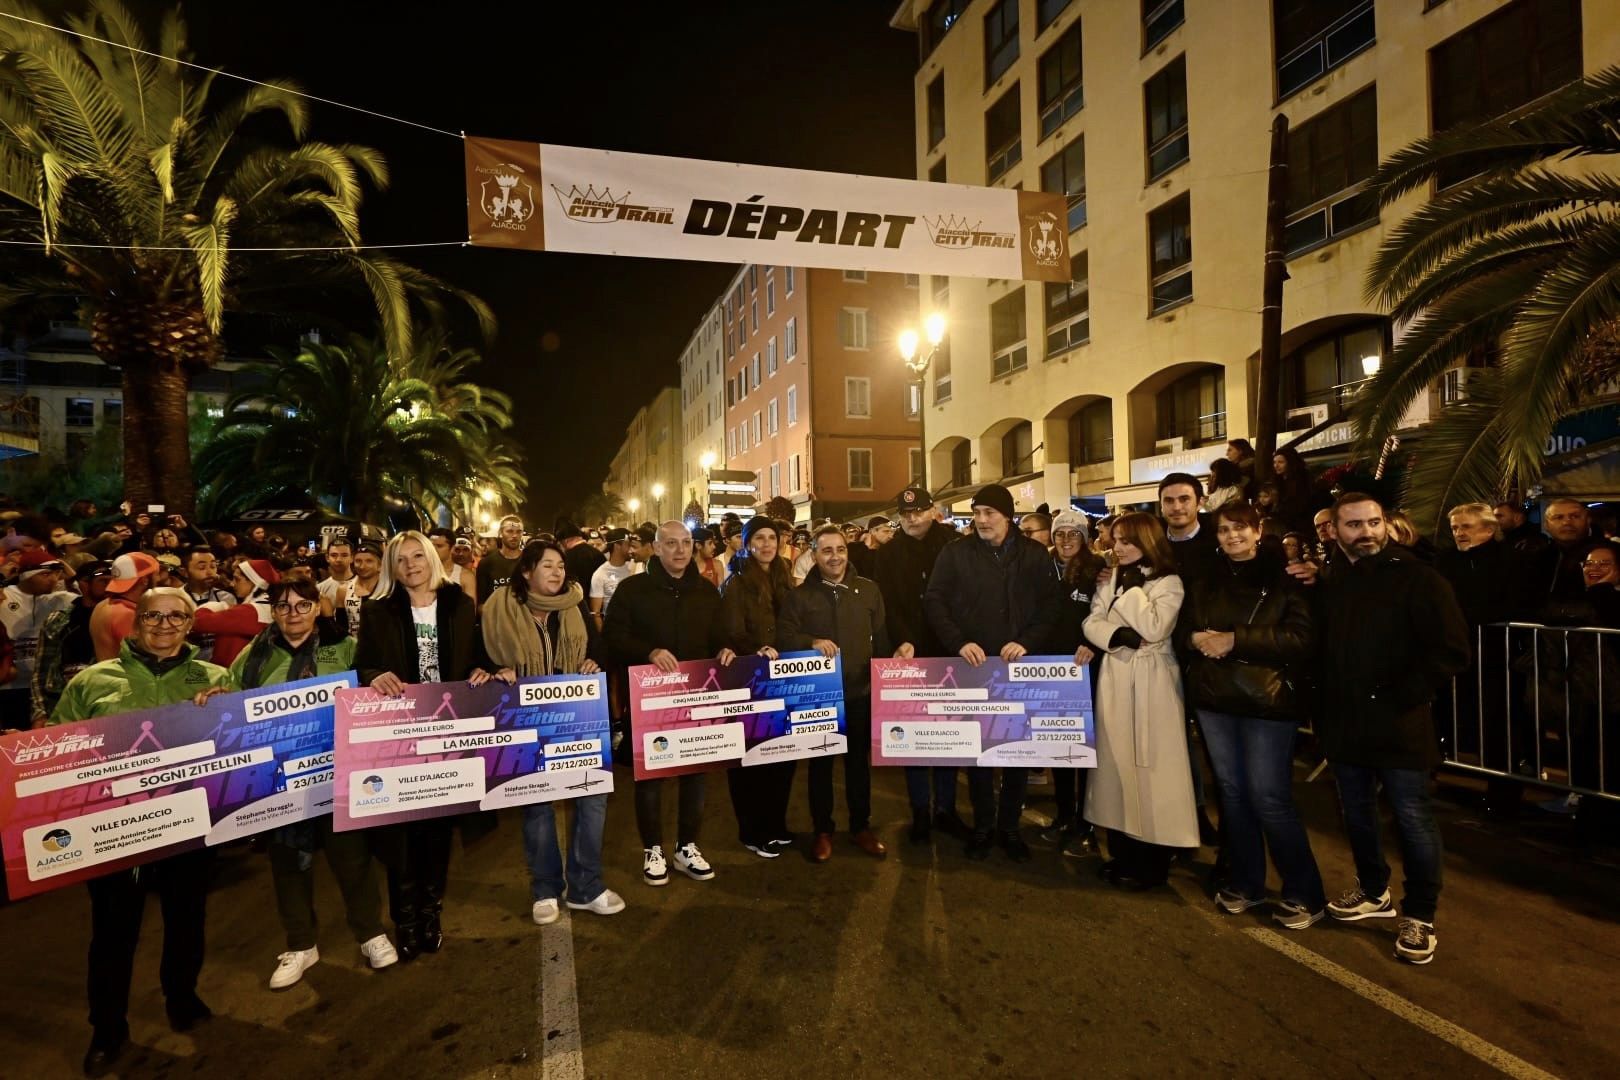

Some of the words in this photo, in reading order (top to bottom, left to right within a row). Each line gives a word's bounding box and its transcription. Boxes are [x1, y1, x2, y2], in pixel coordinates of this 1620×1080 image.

[572, 197, 616, 208] Aiacciu
[568, 205, 616, 219] CITY
[614, 204, 674, 225] TRAIL
[682, 194, 916, 249] DÉPART
[491, 222, 527, 232] AJACCIO
[935, 235, 972, 246] CITY
[971, 231, 1016, 249] TRAIL
[774, 660, 822, 675] 5000,00
[823, 658, 832, 670] €
[1013, 666, 1066, 678] 5000,00
[1069, 666, 1078, 677] €
[525, 685, 583, 701] 5000,00
[586, 684, 595, 696] €
[253, 689, 329, 716] 5000,00
[351, 704, 380, 714] CITY
[380, 699, 416, 712] TRAIL
[723, 704, 754, 714] INSEME
[799, 710, 830, 720] AJACCIO
[412, 725, 431, 733] MILLE
[796, 723, 835, 734] 23/12/2023
[15, 747, 55, 763] CITY
[54, 736, 105, 755] TRAIL
[443, 739, 457, 750] LA
[460, 736, 494, 748] MARIE
[496, 734, 512, 744] DO
[554, 742, 593, 754] AJACCIO
[297, 754, 335, 770] AJACC
[550, 757, 598, 770] 23/12/2023
[649, 753, 674, 761] AJACCIO
[77, 769, 102, 780] CINQ
[103, 762, 130, 774] MILLE
[131, 755, 161, 768] EUROS
[139, 768, 186, 788] SOGNI
[190, 753, 252, 776] ZITELLINI
[398, 775, 419, 784] VILLE
[420, 771, 459, 781] D'AJACCIO
[356, 797, 390, 807] AJACCIO
[91, 820, 120, 834] VILLE
[121, 808, 173, 828] D'AJACCIO
[235, 810, 267, 821] Stéphane
[93, 837, 119, 848] Avenue
[120, 830, 147, 841] Antoine
[147, 822, 172, 834] Serafini
[173, 820, 182, 828] BP
[183, 817, 195, 826] 412
[94, 844, 116, 855] 20304
[117, 838, 142, 849] Ajaccio
[143, 832, 163, 843] Cedex
[36, 849, 82, 868] AJACCIO
